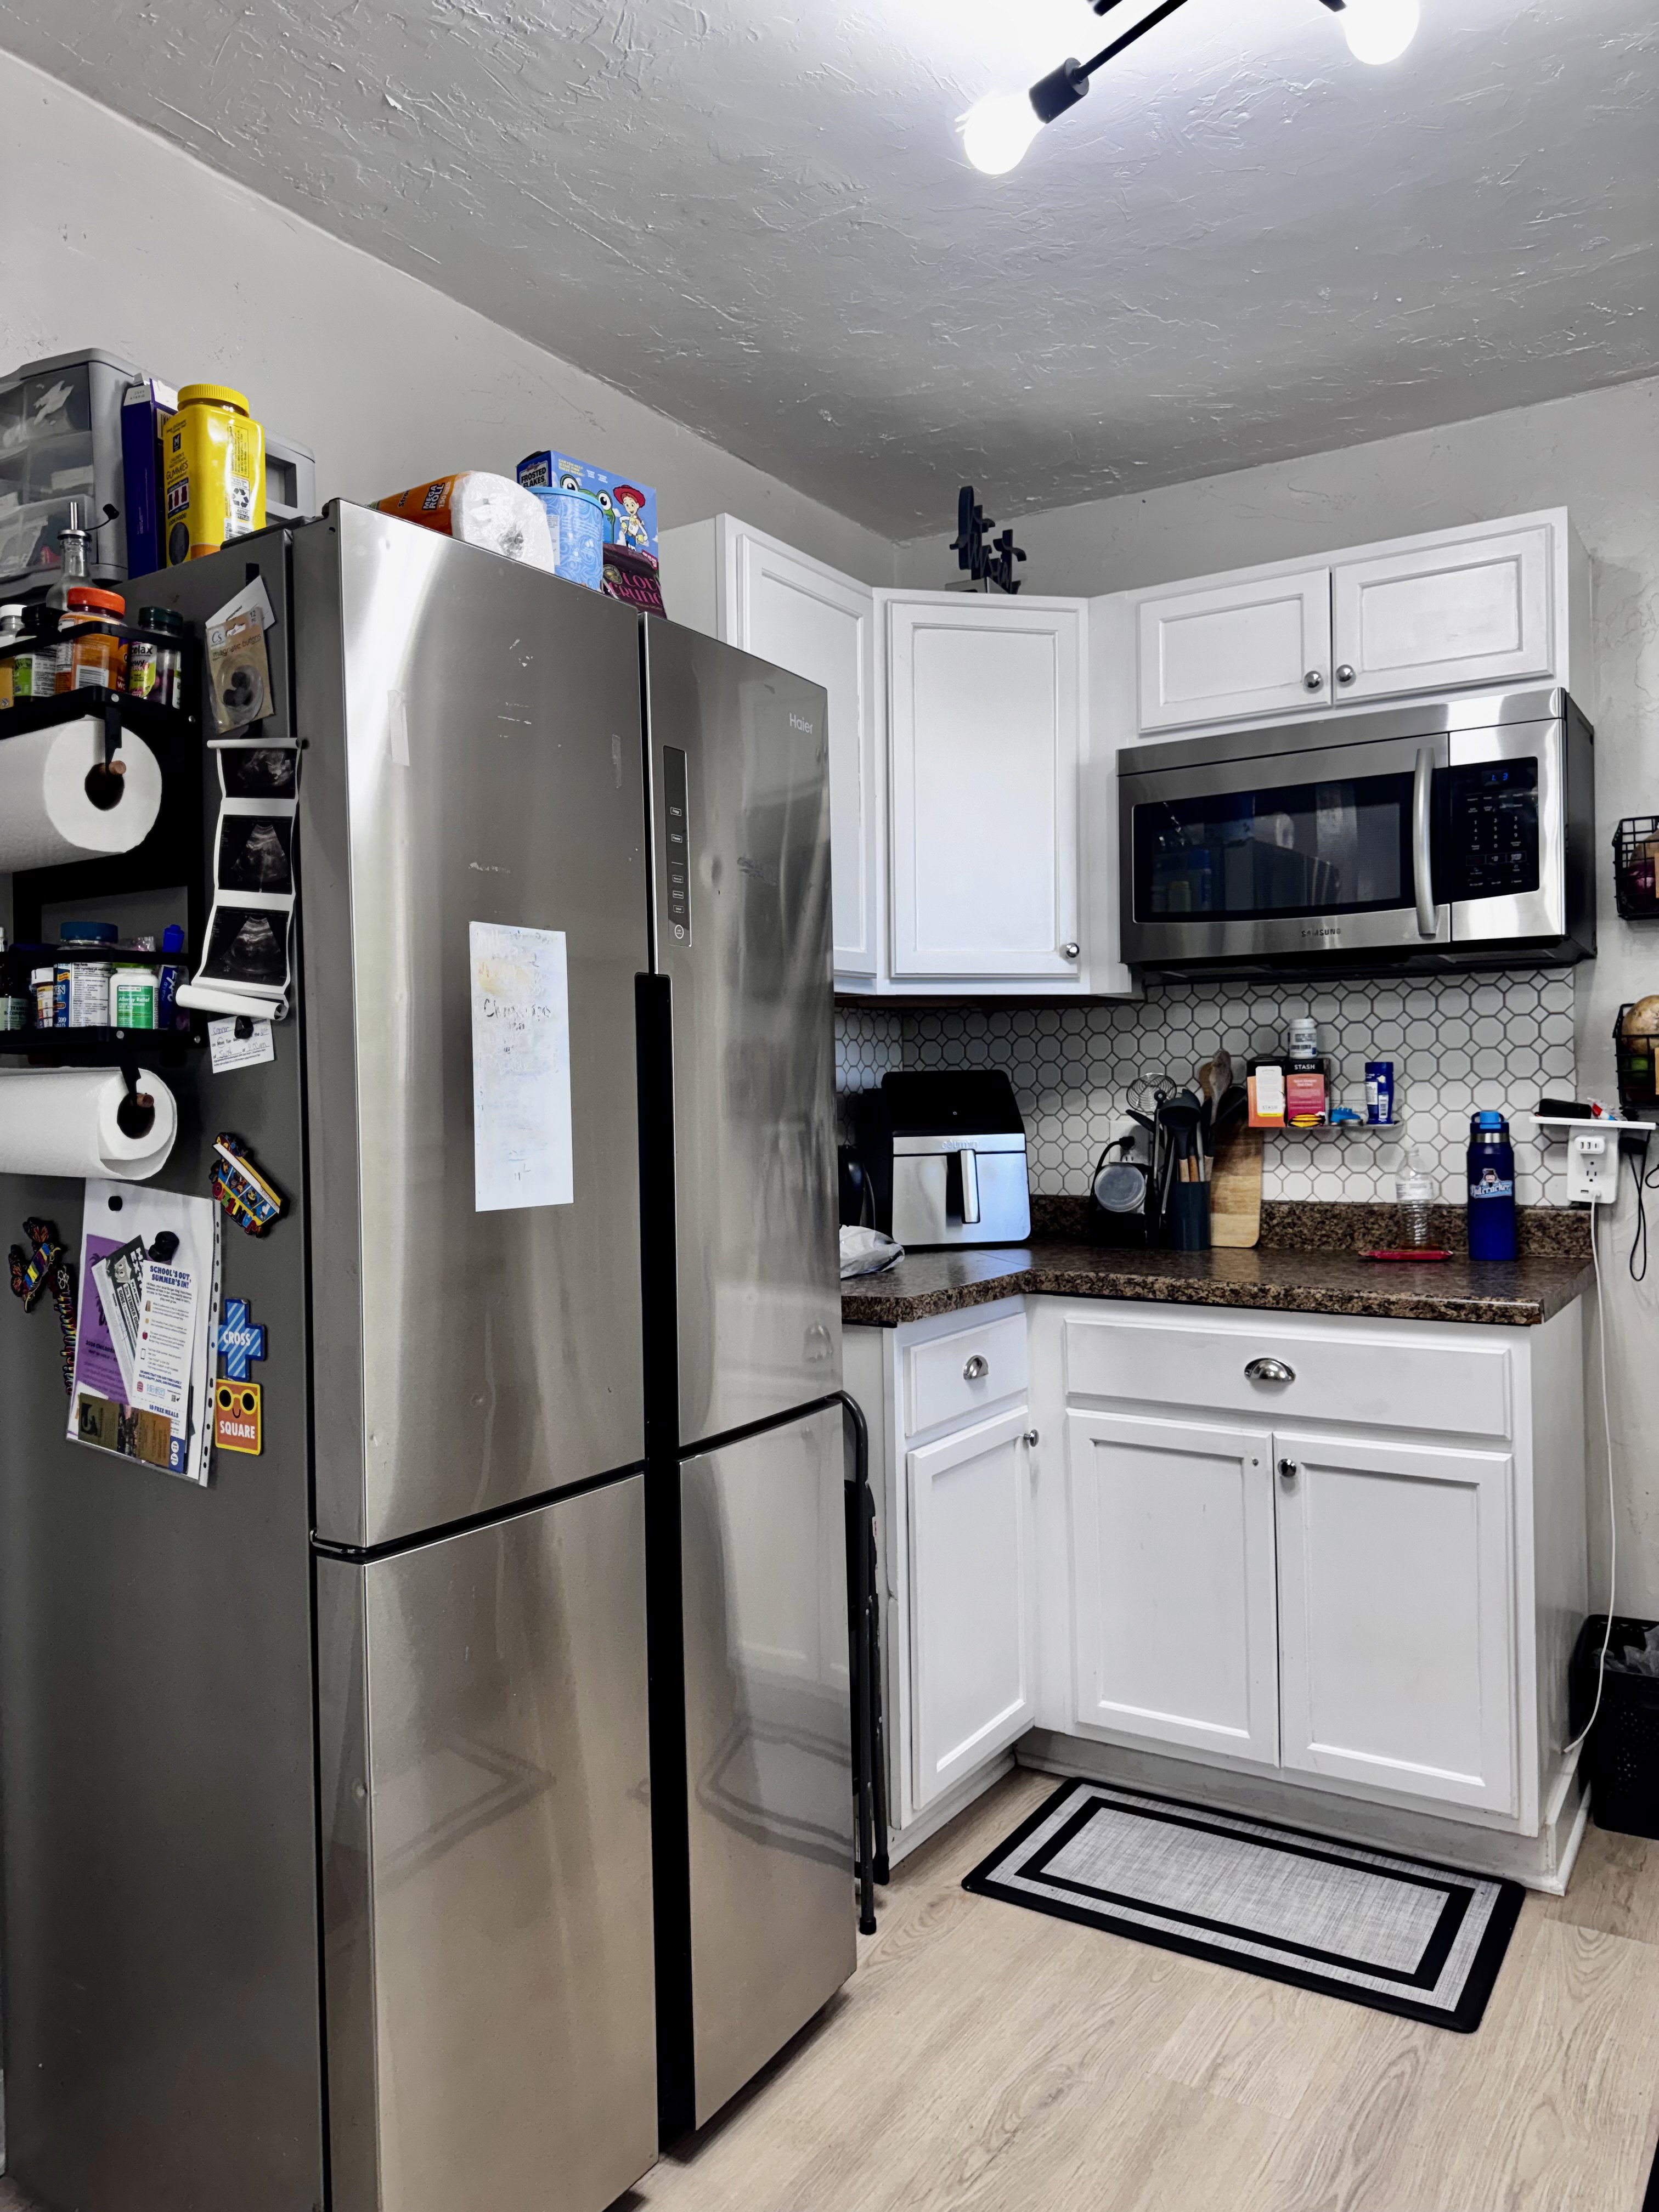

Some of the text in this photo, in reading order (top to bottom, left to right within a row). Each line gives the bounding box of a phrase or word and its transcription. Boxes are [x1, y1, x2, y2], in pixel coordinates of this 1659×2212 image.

[521, 467, 546, 483] FROSTED
[523, 476, 545, 487] FLAKES
[423, 485, 437, 509] MEGA
[429, 483, 444, 509] ROLL
[622, 572, 658, 591] LOV
[608, 582, 662, 606] CRUNC
[213, 634, 261, 658] magnetic buttons
[789, 712, 813, 734] Haier
[1301, 928, 1341, 938] SAMSUNG
[150, 1265, 191, 1283] SCHOOL'S OUT,
[152, 1274, 189, 1289] SUMMER'S IN!
[128, 1295, 136, 1317] TENDER
[223, 1330, 251, 1346] CROSS
[154, 1406, 165, 1414] FREE
[165, 1409, 179, 1419] MEALS
[219, 1420, 255, 1439] SQUARE
